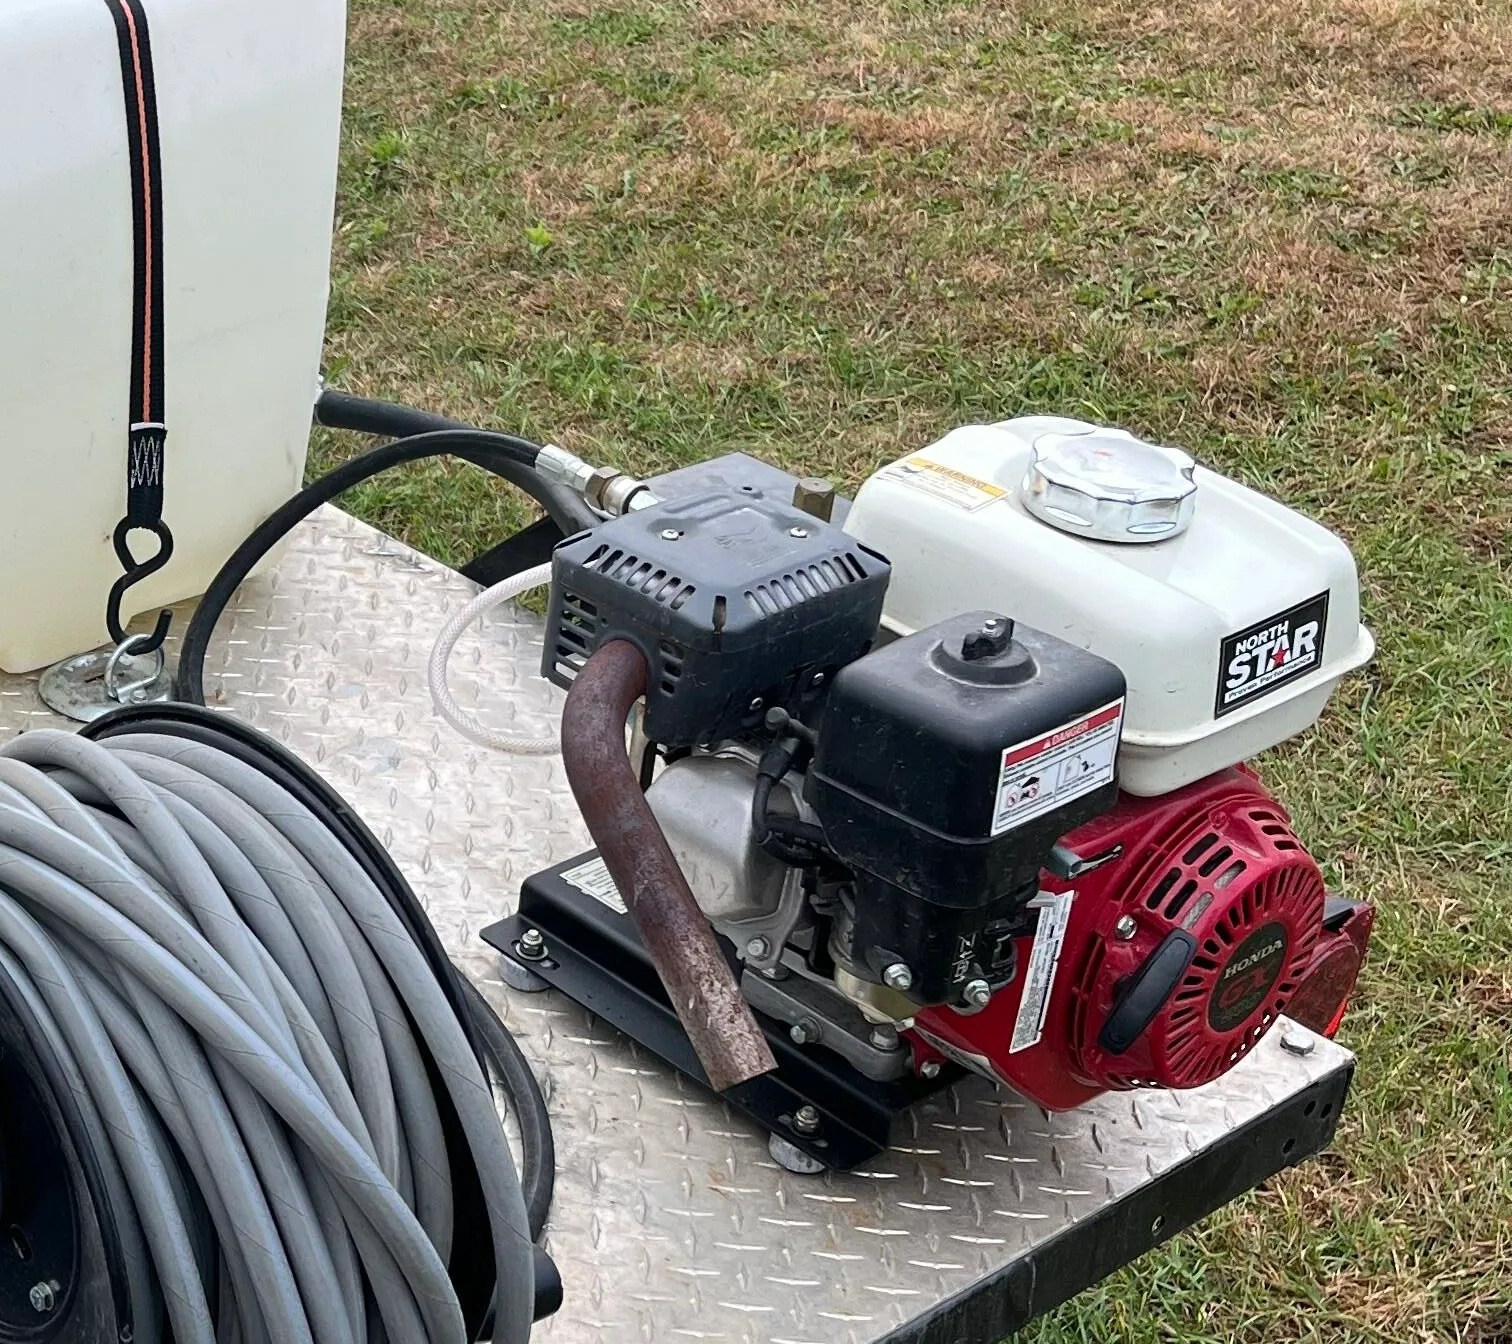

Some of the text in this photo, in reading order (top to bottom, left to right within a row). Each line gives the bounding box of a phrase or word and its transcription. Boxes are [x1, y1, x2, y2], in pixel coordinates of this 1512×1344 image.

[1226, 621, 1319, 689] STAR
[1235, 620, 1289, 656] NORTH
[1224, 940, 1283, 979] HONDA
